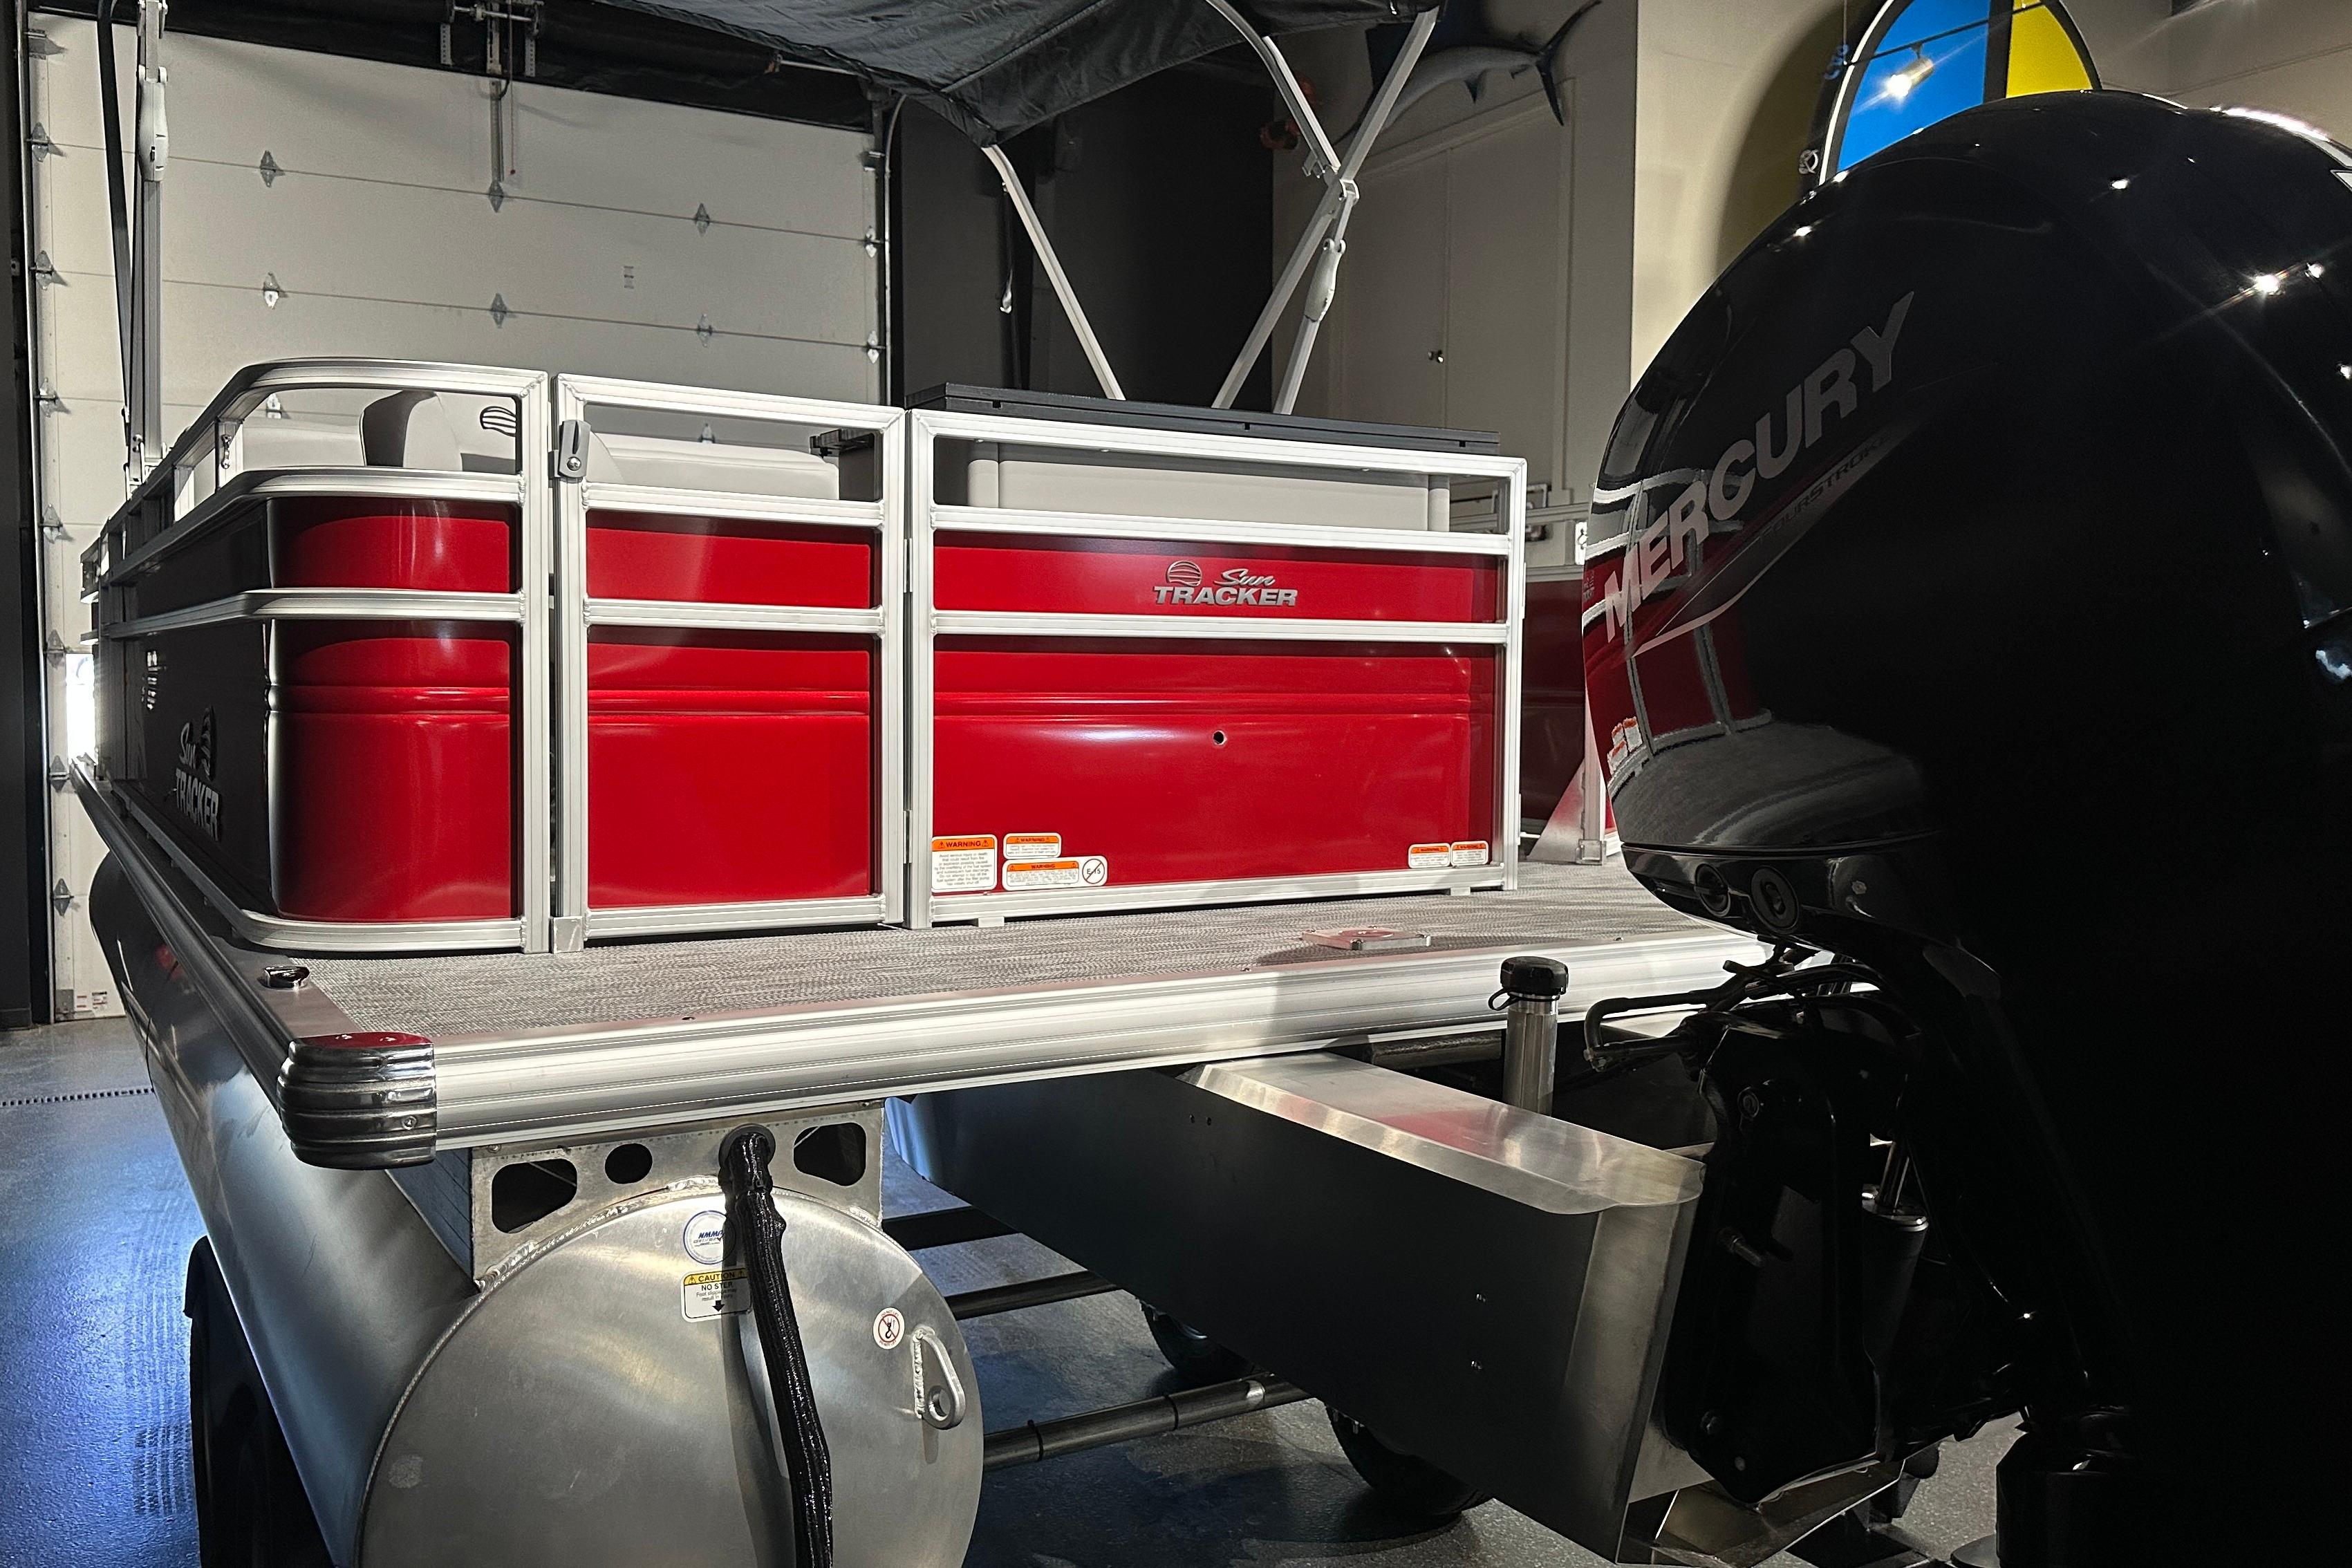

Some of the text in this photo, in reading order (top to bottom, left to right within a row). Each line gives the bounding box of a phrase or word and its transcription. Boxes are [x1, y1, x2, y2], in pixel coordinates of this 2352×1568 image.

[1604, 291, 1914, 642] MERCURY
[1213, 568, 1276, 586] Sun
[1153, 586, 1298, 606] TRACKER
[176, 767, 219, 841] TRACKER
[698, 1272, 735, 1282] CAUTION
